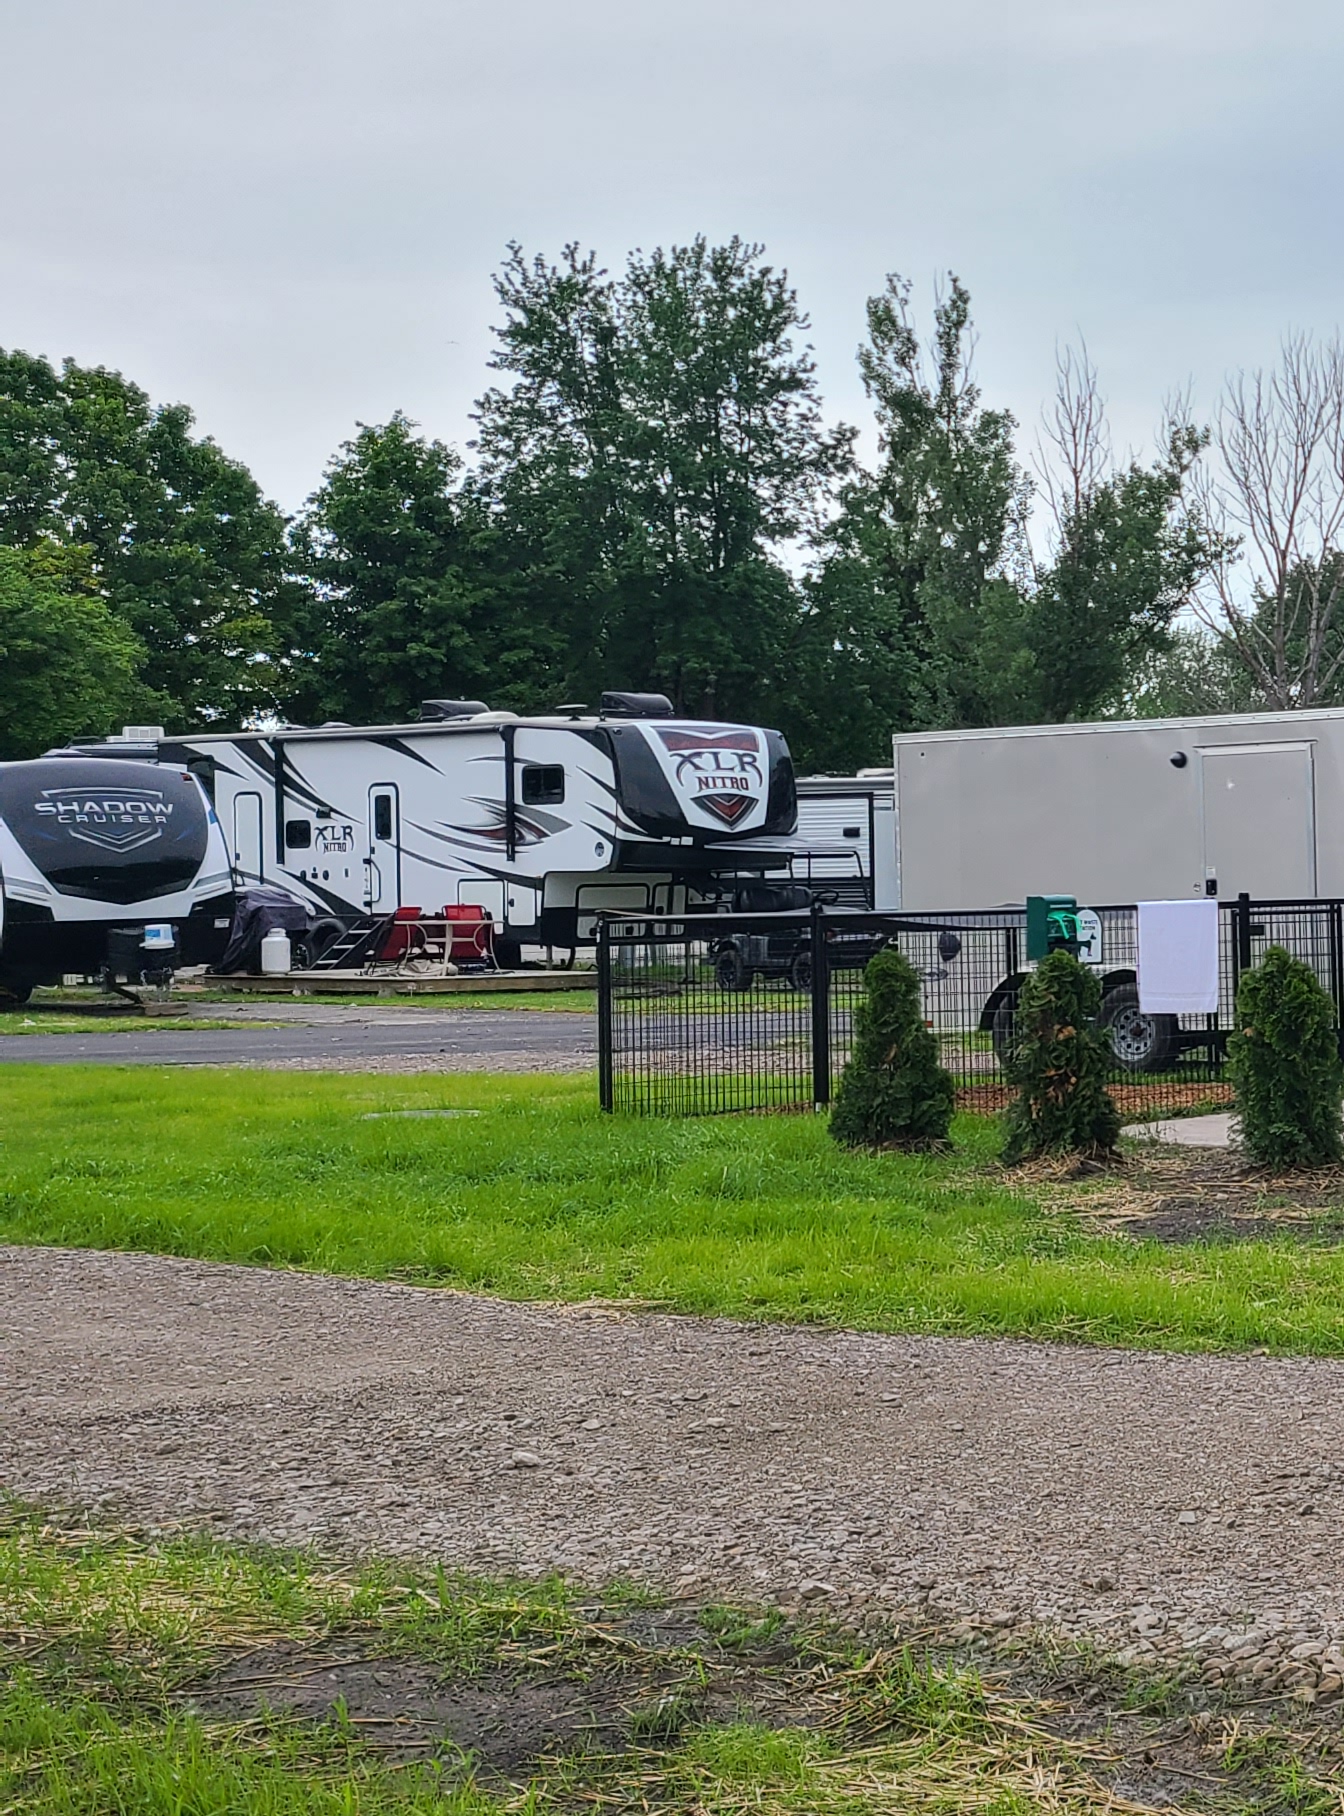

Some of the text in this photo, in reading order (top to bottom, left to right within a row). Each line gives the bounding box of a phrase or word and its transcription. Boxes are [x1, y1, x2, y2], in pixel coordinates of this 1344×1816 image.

[669, 751, 763, 788] XLR
[695, 776, 749, 793] NITRO
[34, 801, 174, 816] SHADOW
[57, 814, 168, 824] CRUISER
[314, 825, 354, 851] XLR
